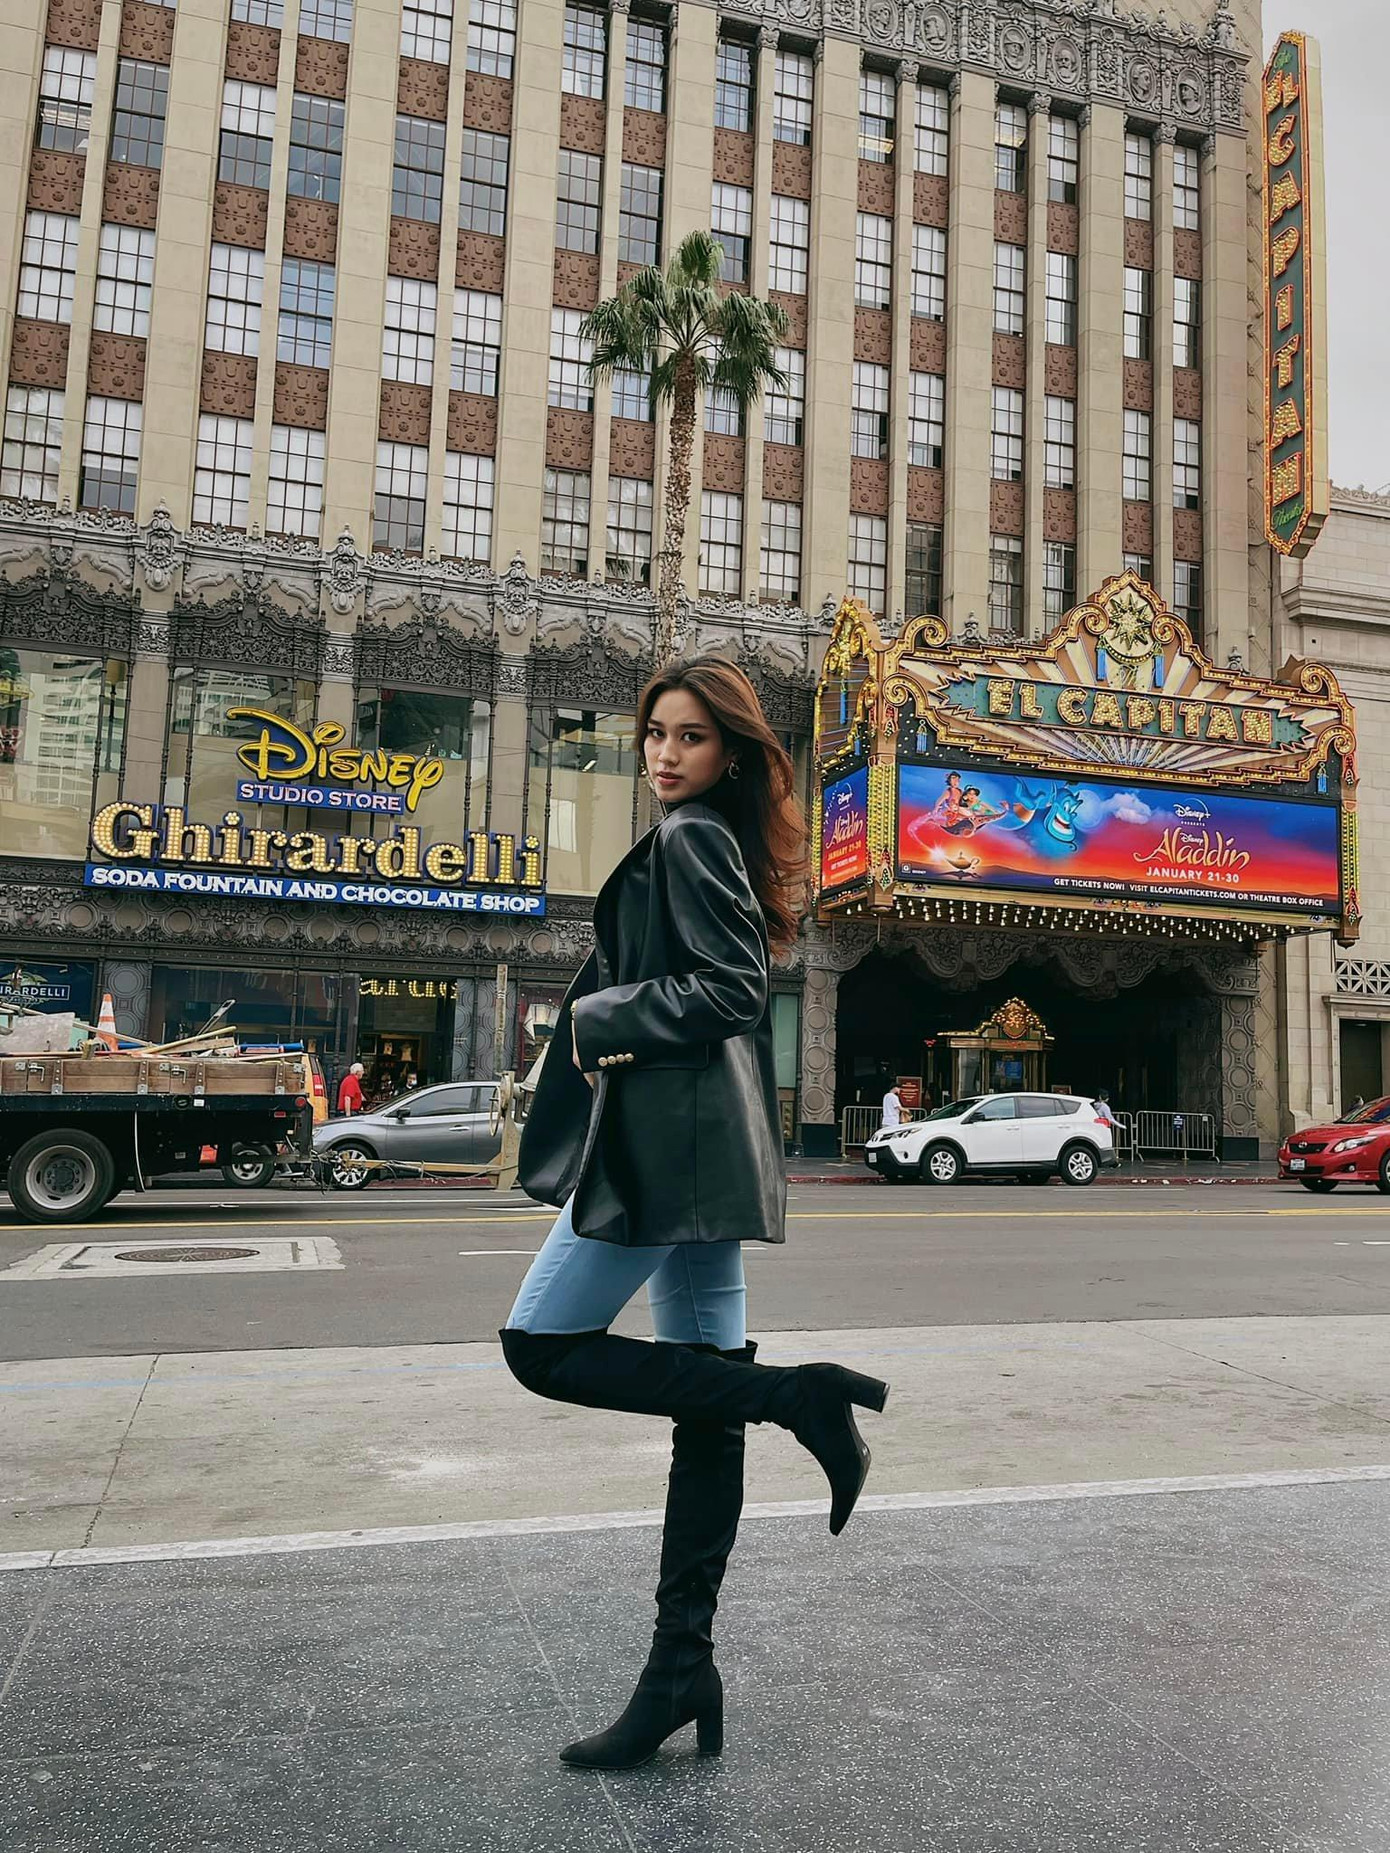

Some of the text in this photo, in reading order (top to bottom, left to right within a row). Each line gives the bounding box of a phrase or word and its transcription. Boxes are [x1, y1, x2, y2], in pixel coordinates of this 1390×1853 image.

[1266, 70, 1300, 114] EL
[1267, 114, 1303, 507] CAPITAN
[987, 679, 1272, 745] EL CAPITAN
[240, 783, 402, 811] STUDIO STORE
[92, 801, 543, 887] Ghirardelli
[1133, 827, 1250, 870] Aladdin
[1180, 832, 1204, 845] Disney
[92, 868, 540, 912] SODA FOUNTAIN AND CHOCOLATE SHOP
[1054, 878, 1069, 886] GET
[1071, 880, 1101, 888] TICKETS
[1130, 884, 1147, 892] VISIT
[1150, 885, 1236, 899] ELCAPITANTICKETS.COM
[1250, 894, 1280, 903] THEATRE
[1283, 896, 1297, 904] BOX
[1299, 898, 1323, 907] OFFICE
[1146, 867, 1239, 883] JANUARY 21-30
